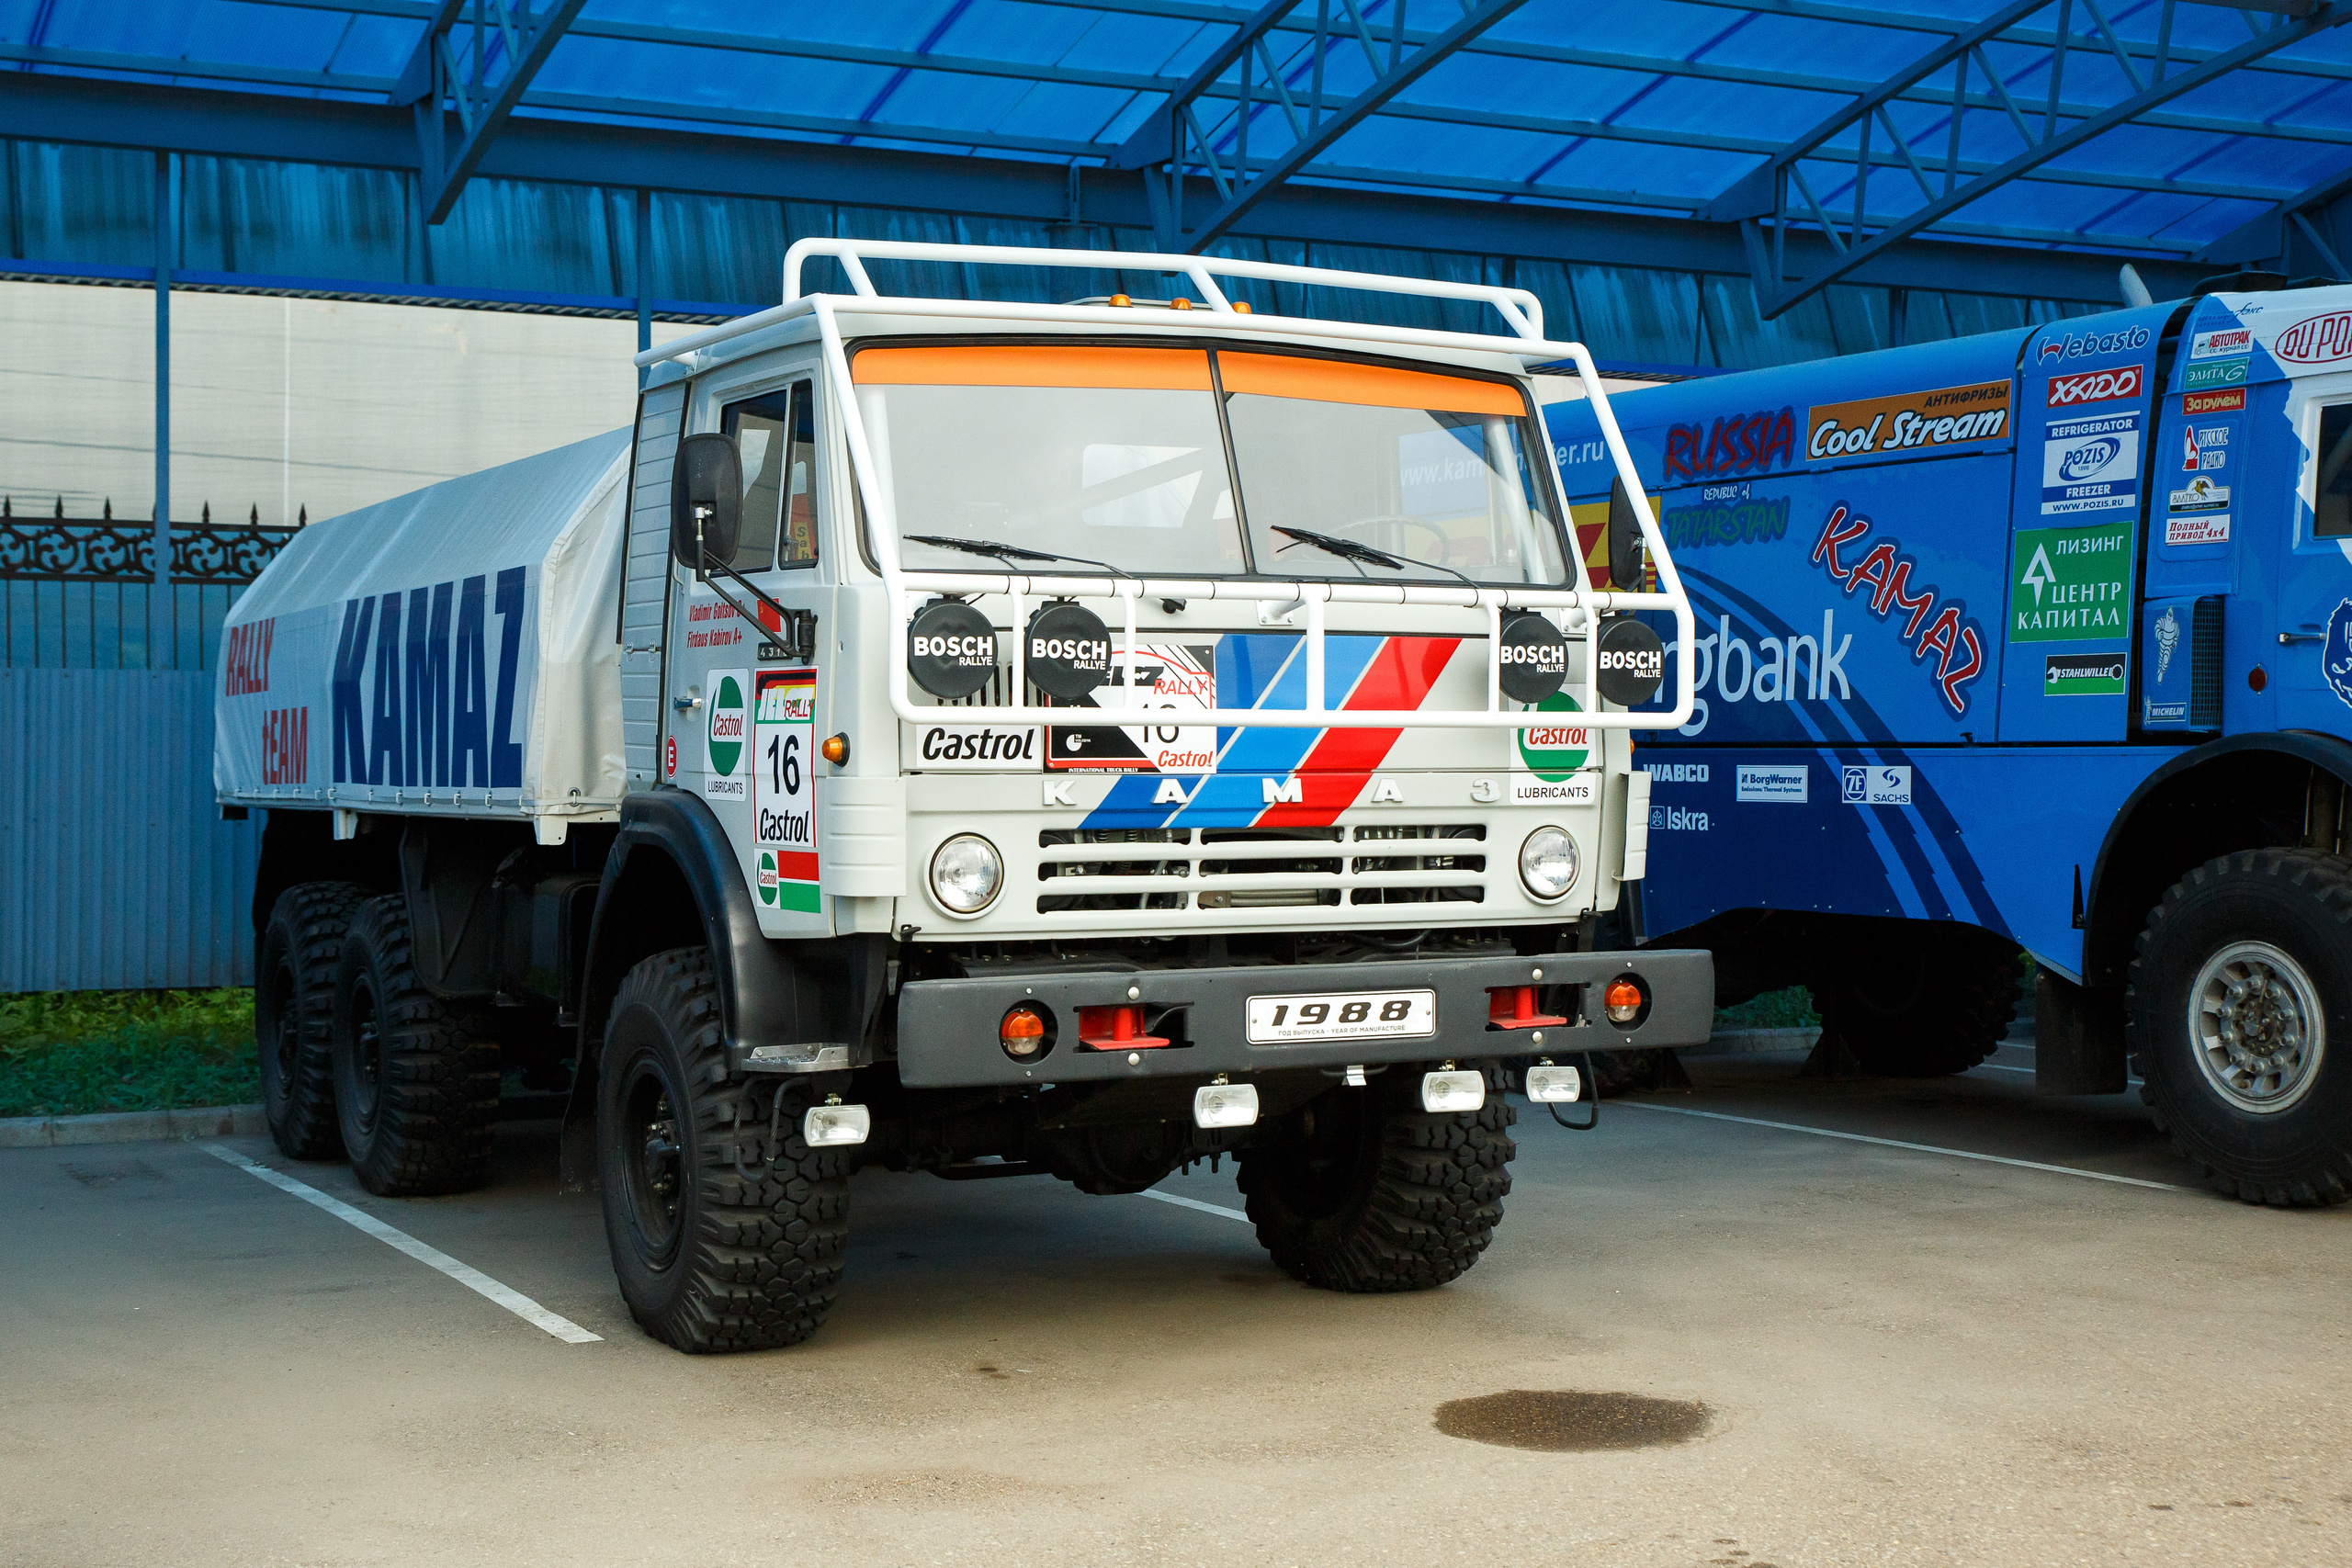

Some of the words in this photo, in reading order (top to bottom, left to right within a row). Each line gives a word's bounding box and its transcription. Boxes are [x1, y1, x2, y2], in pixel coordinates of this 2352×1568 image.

[2036, 325, 2150, 366] Webasto
[2209, 330, 2252, 348] АВТОТРАК
[2316, 316, 2352, 358] PO
[2188, 368, 2224, 381] ЭЛИТА
[1923, 384, 2008, 408] АНТИФРИЗЫ
[2050, 371, 2136, 405] XADO
[2187, 397, 2201, 412] За
[1809, 420, 1881, 459] Cool
[1883, 407, 2006, 450] Stream
[2052, 419, 2132, 437] REFRIGERATOR
[1666, 412, 1792, 476] RUSSIA
[2064, 447, 2105, 467] POZIS
[1703, 486, 1737, 500] REPUBLIC
[1741, 484, 1750, 500] of
[2066, 484, 2111, 498] FREEZER
[2052, 499, 2124, 512] WWW.POZIS.RU
[1668, 502, 1787, 545] TATARSTAN
[2056, 536, 2124, 555] ЛИЗИНГ
[2052, 582, 2121, 606] ЦЕНТР
[1812, 506, 1981, 714] KAMAZ
[2018, 606, 2120, 630] КАПИТАЛ
[686, 630, 708, 649] Firdaus
[709, 628, 733, 646] Kabirov
[732, 627, 742, 645] A+
[913, 636, 993, 657] BOSCH
[226, 617, 276, 696] RALLY
[1032, 638, 1107, 660] BOSCH
[1500, 646, 1565, 664] BOSCH
[958, 657, 993, 666] RALLYE
[1073, 660, 1106, 671] RALLYE
[1536, 663, 1565, 672] RALLYE
[1600, 650, 1661, 669] BOSCH
[332, 565, 526, 788] KAMAZ
[1634, 669, 1661, 678] RALLYE
[2061, 668, 2109, 678] STAHLWILLE
[1154, 680, 1207, 695] RALLY
[784, 699, 816, 717] RALLY
[2152, 707, 2185, 716] MICHELIN
[713, 712, 743, 737] Castrol
[922, 728, 1035, 761] Castrol
[1529, 728, 1588, 745] Castrol
[668, 746, 674, 767] E
[767, 734, 800, 795] 16
[1158, 750, 1213, 768] Castrol
[1644, 764, 1709, 783] WABCO
[1750, 773, 1803, 785] BorgWarner
[707, 781, 743, 795] LUBRICANTS
[1517, 786, 1589, 799] LUBRICANTS
[1846, 775, 1865, 794] ZF
[1873, 794, 1909, 803] SACHS
[760, 807, 809, 843] Castrol
[1668, 807, 1709, 830] Iskra
[759, 870, 777, 886] Castrol
[1272, 999, 1412, 1026] 1988
